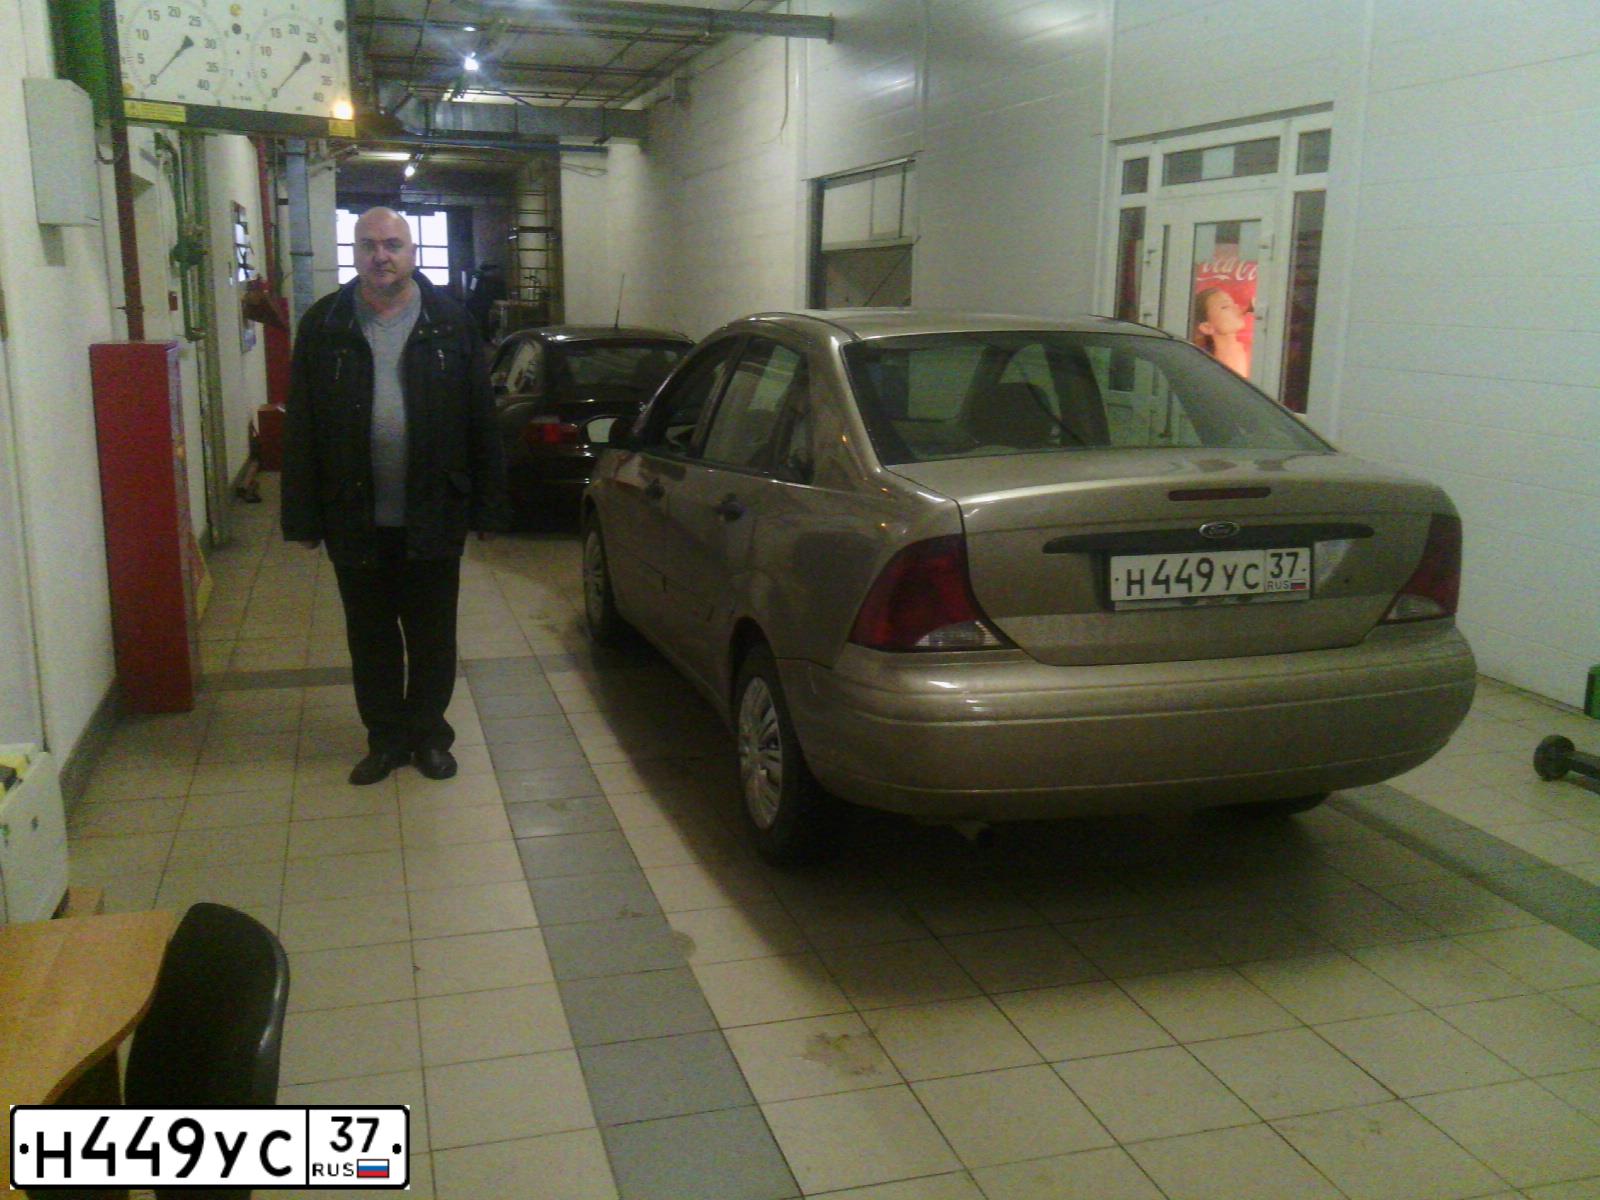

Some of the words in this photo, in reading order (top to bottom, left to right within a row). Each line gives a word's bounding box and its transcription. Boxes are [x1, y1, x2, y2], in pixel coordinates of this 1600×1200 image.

[147, 9, 160, 21] 15
[168, 6, 181, 18] 20
[188, 15, 201, 27] 25
[136, 28, 150, 41] 10
[269, 27, 283, 39] 15
[260, 45, 273, 57] 10
[137, 53, 145, 64] 5
[260, 67, 268, 79] 5
[271, 87, 279, 99] 0
[1269, 552, 1300, 579] 37
[1267, 580, 1290, 590] RUS
